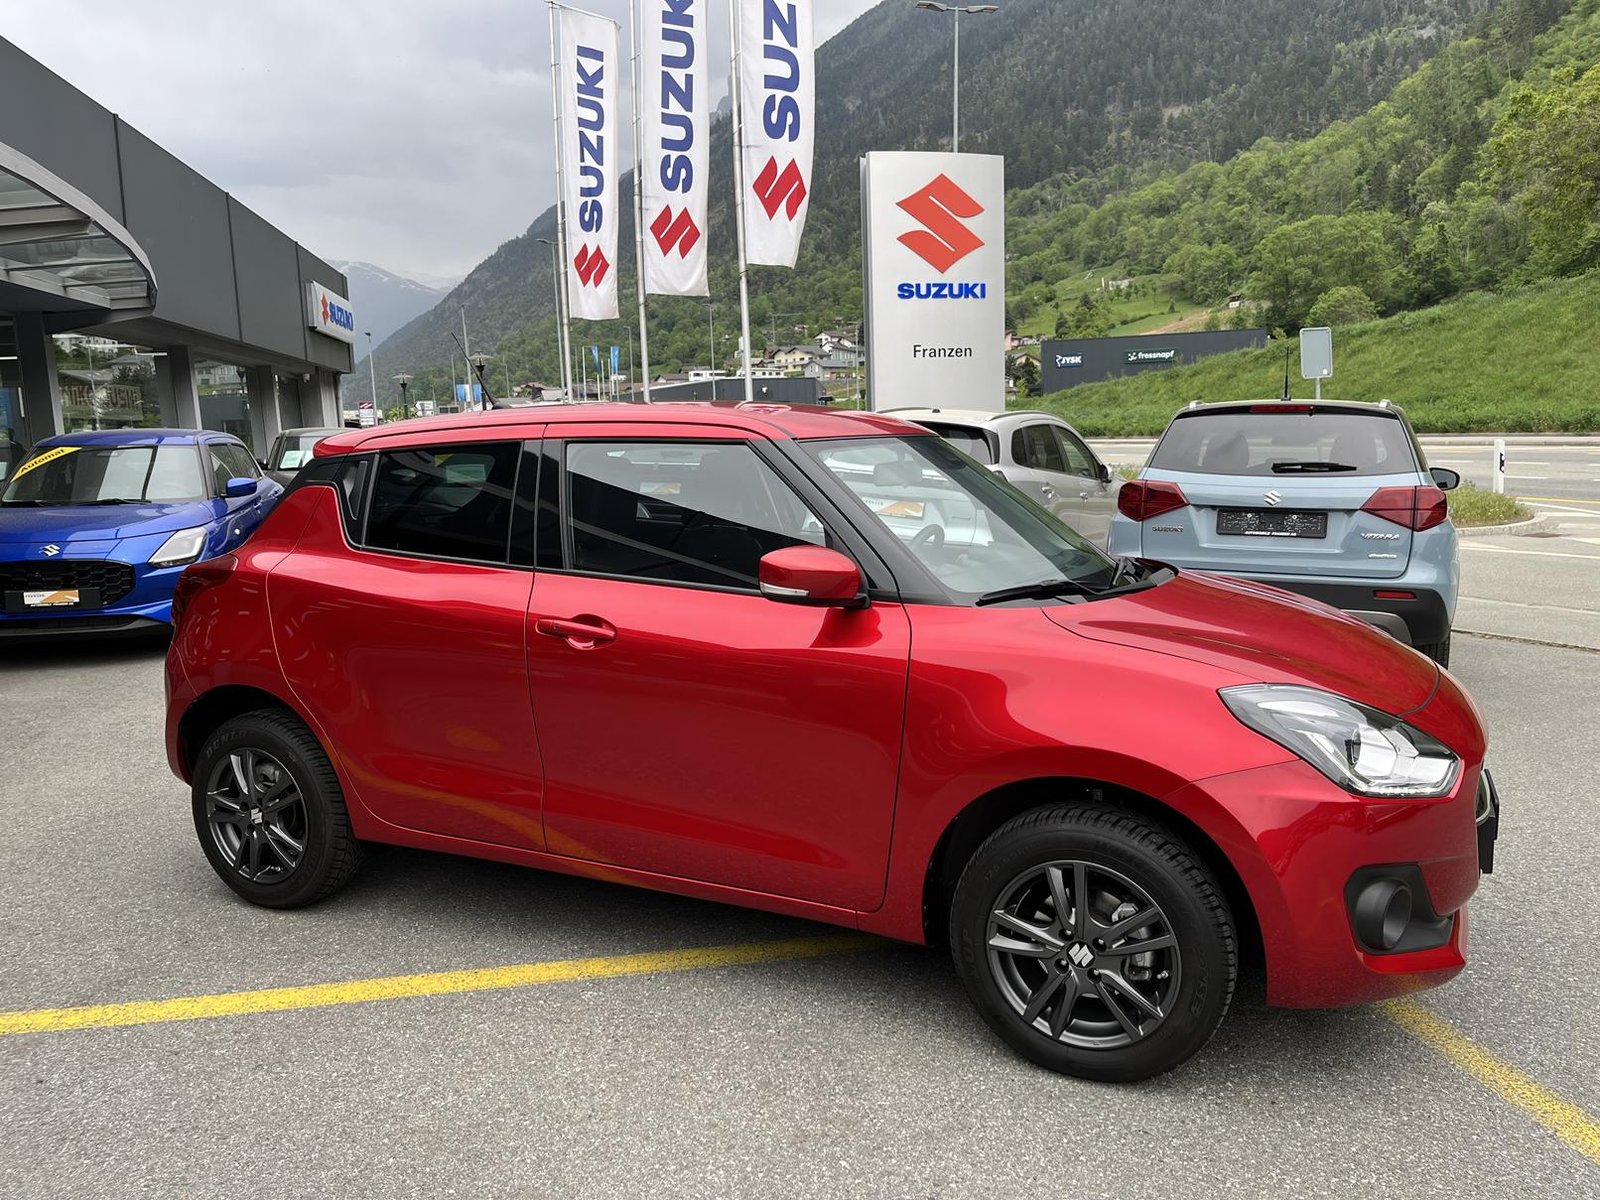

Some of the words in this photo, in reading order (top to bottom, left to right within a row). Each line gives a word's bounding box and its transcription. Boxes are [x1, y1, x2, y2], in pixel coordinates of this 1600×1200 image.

[576, 45, 605, 233] SUZUKI
[897, 282, 987, 300] SUZUKI
[329, 301, 354, 331] SUZUKI
[913, 344, 972, 358] Franzen
[1138, 350, 1175, 361] fressnapf
[1060, 355, 1082, 364] JYSK
[20, 448, 65, 473] Automat
[1360, 533, 1400, 541] VITARA
